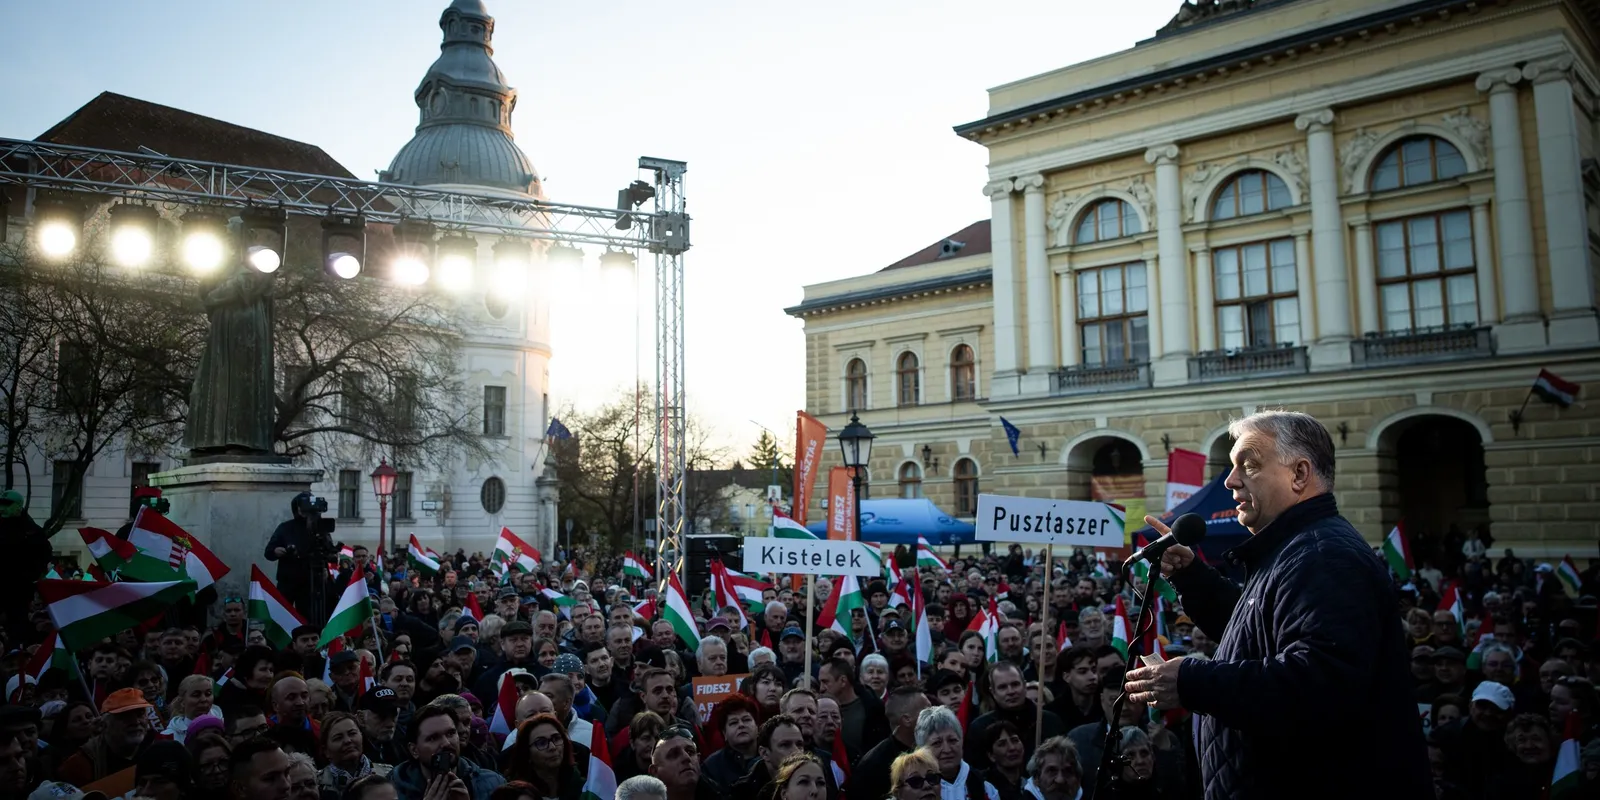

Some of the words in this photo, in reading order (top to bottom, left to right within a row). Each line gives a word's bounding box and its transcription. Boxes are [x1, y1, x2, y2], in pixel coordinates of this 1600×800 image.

[833, 494, 846, 533] FIDESZ
[993, 506, 1110, 536] Pusztaszer
[761, 545, 862, 568] Kistelek
[697, 683, 730, 694] FIDESZ
